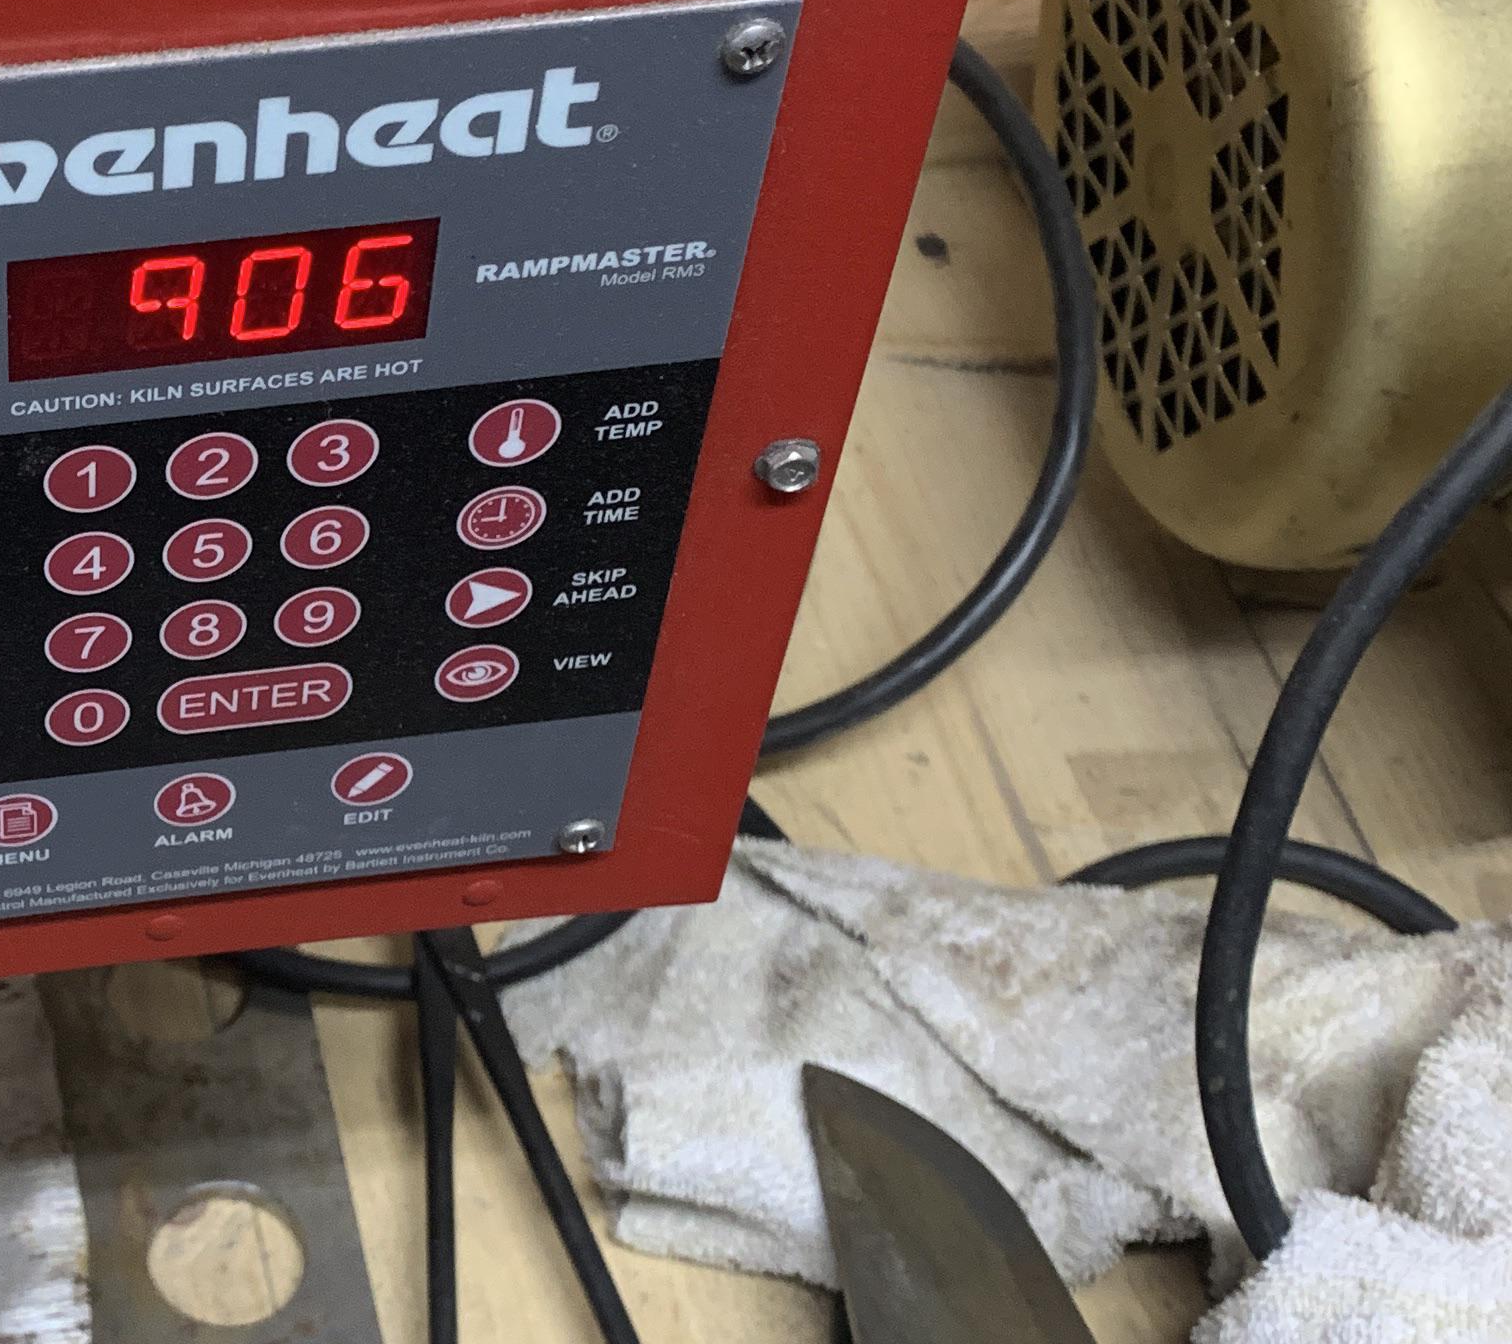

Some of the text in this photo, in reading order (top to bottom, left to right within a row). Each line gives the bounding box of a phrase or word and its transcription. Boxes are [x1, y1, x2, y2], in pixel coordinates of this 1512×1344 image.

[475, 241, 709, 284] RAMPMASTER
[600, 263, 706, 287] Model RM3
[130, 235, 413, 341] 906
[10, 359, 424, 417] CAUTION: KILN SURFACES ARE HOT
[604, 400, 659, 421] ADD
[594, 420, 663, 441] TEMP
[195, 447, 230, 487] 2
[316, 434, 350, 472] 3
[76, 461, 98, 498] 1
[587, 487, 641, 506] ADD
[583, 506, 641, 525] TIME
[192, 532, 225, 568] 5
[309, 519, 343, 555] 6
[72, 546, 106, 581] 4
[571, 567, 627, 587] SKIP
[552, 584, 637, 607] AHEAD
[188, 613, 220, 647] 8
[302, 600, 335, 635] 9
[73, 625, 106, 660] 7
[553, 652, 613, 671] VIEW
[178, 678, 332, 719] ENTER
[73, 701, 105, 734] 0
[343, 808, 394, 825] EDIT
[154, 827, 233, 848] ALARM
[29, 886, 132, 906] Manufactured
[136, 875, 219, 895] Exclusively
[224, 873, 244, 885] for
[248, 865, 318, 882] Evenheat
[323, 862, 341, 874] by
[402, 846, 481, 864] Instrument
[46, 879, 97, 894] Legion
[151, 865, 219, 881] Caseville
[224, 857, 291, 873] Michigan
